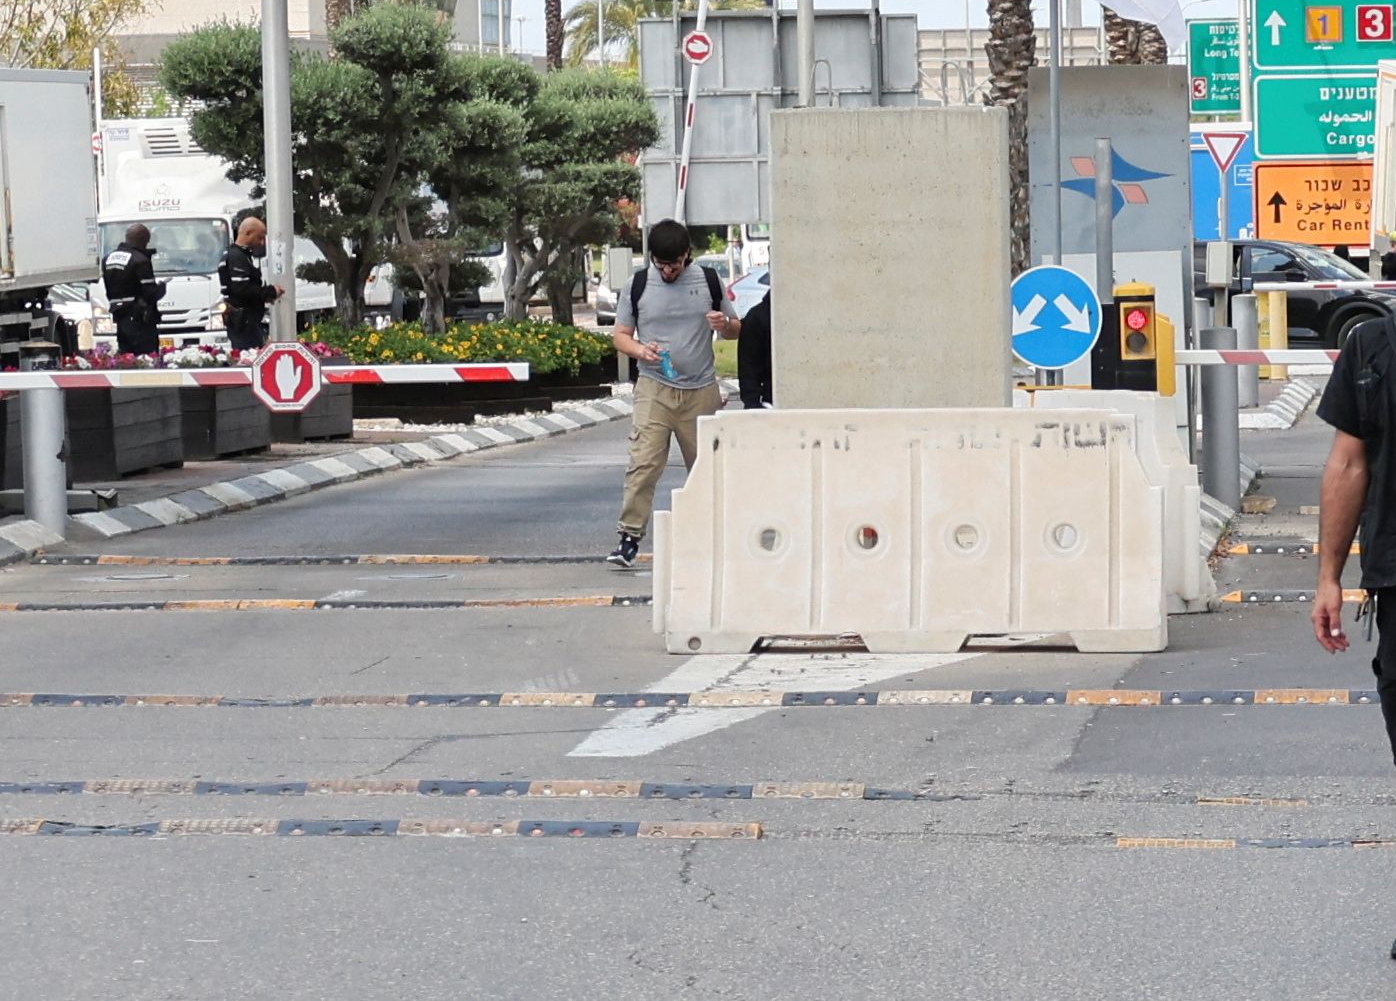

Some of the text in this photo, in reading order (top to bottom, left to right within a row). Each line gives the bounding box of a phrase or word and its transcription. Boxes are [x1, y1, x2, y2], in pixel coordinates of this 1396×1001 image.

[1317, 13, 1330, 36] 1
[1364, 9, 1386, 38] 3
[1204, 48, 1227, 59] Long
[1194, 79, 1206, 98] 3
[1326, 131, 1375, 148] Cargo
[1304, 179, 1371, 192] כב שכור
[138, 199, 181, 207] ISUZU
[1297, 219, 1370, 231] Car Rent
